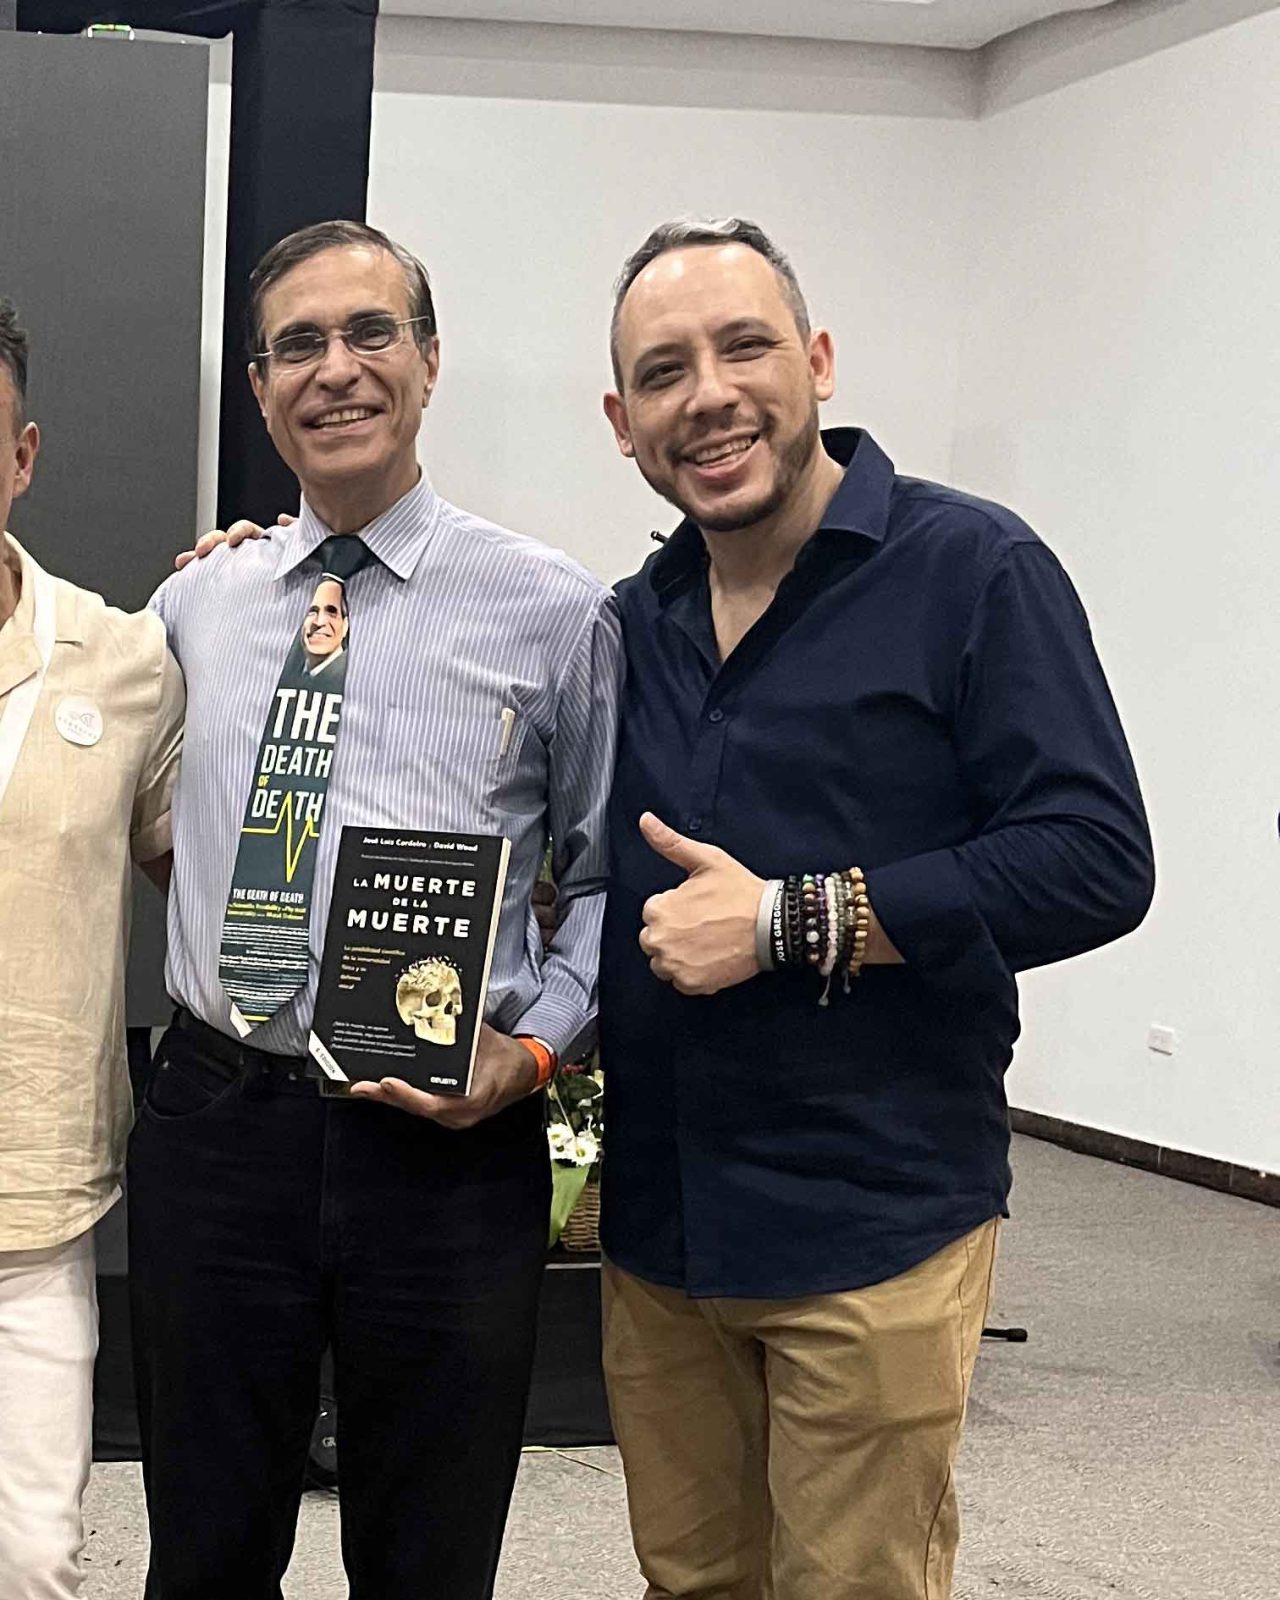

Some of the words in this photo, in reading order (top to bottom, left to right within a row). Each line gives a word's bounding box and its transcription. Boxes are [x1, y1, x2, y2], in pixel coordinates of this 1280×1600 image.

[272, 688, 343, 744] THE
[260, 744, 334, 778] DEATH
[258, 775, 270, 787] OF
[251, 788, 324, 823] DEATH
[433, 841, 455, 850] David
[233, 888, 246, 900] THE
[269, 891, 279, 902] OF
[280, 891, 304, 904] DEATH
[353, 878, 369, 888] LA
[373, 873, 476, 897] MUERTE
[392, 897, 409, 907] DE
[412, 899, 429, 909] LA
[347, 908, 471, 938] MUERTE
[775, 939, 786, 962] JOSE
